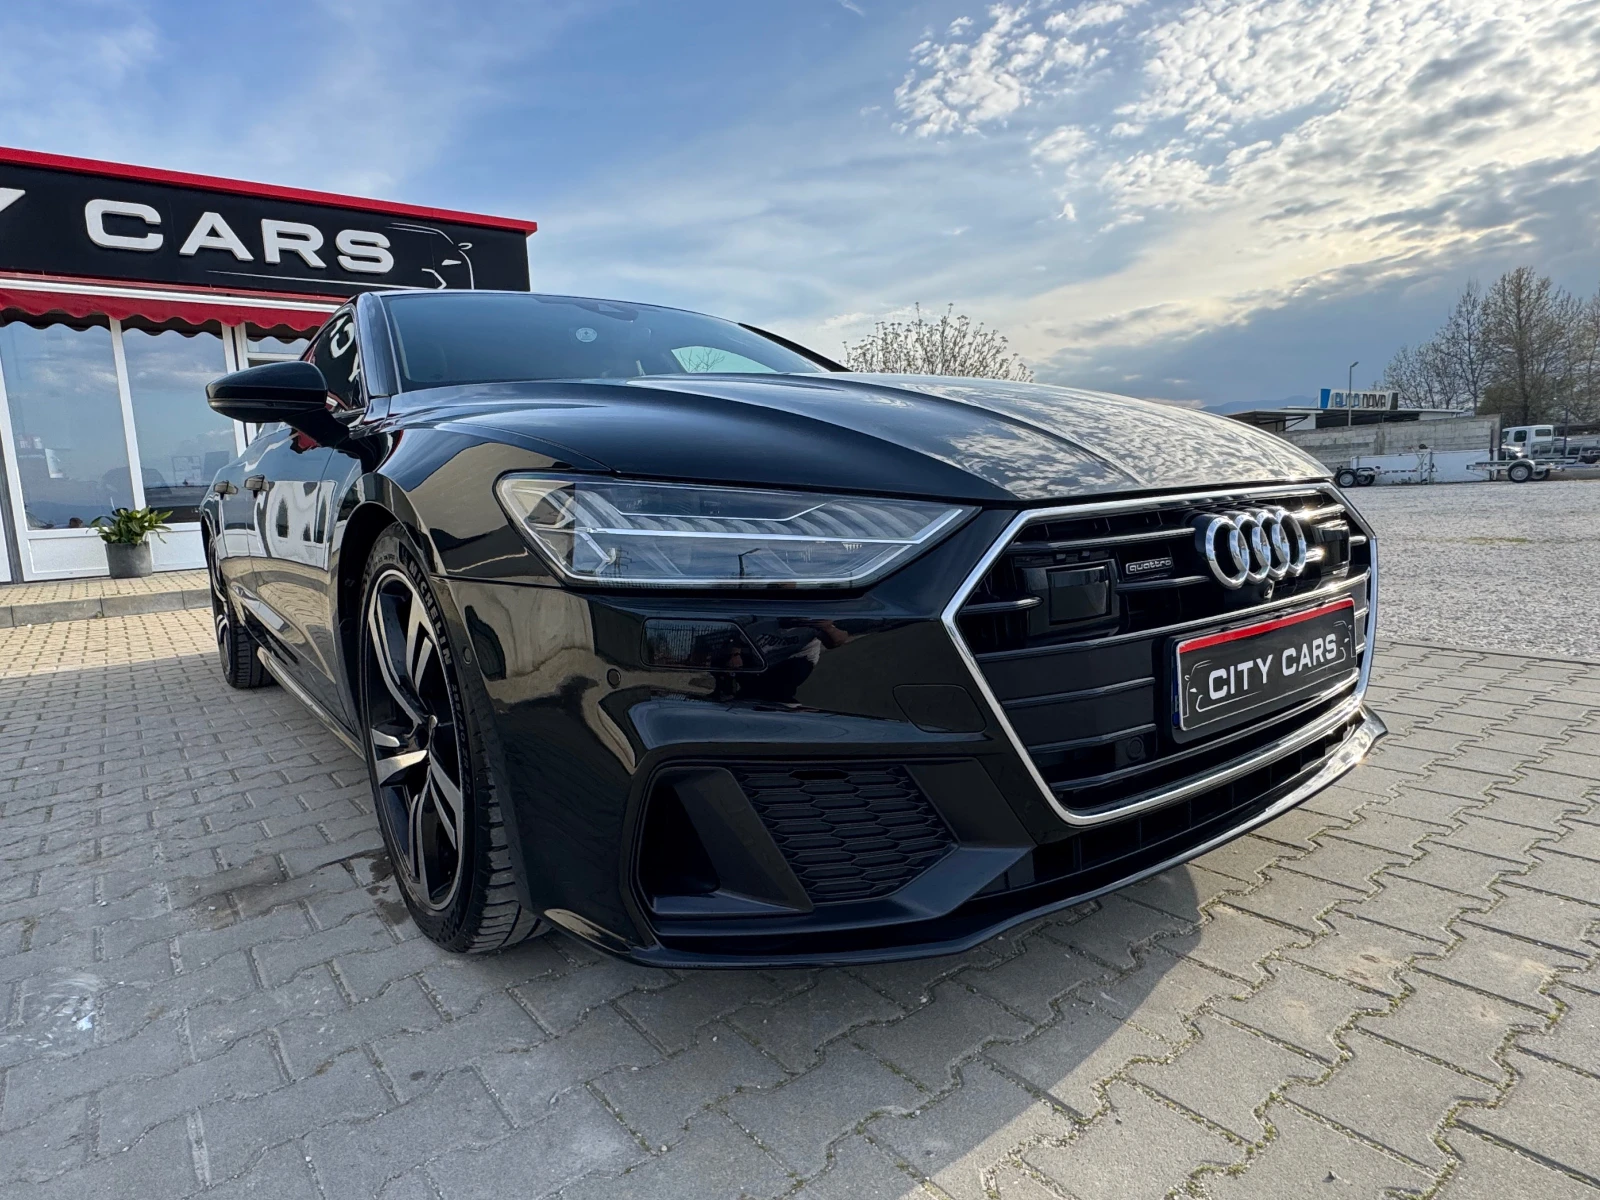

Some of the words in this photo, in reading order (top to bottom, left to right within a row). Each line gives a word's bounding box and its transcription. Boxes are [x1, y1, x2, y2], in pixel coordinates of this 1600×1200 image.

[84, 198, 395, 275] CARS
[1129, 559, 1172, 573] quattro
[408, 560, 452, 666] MICHELIN
[1208, 653, 1274, 701] CITY
[1281, 633, 1338, 677] CARS
